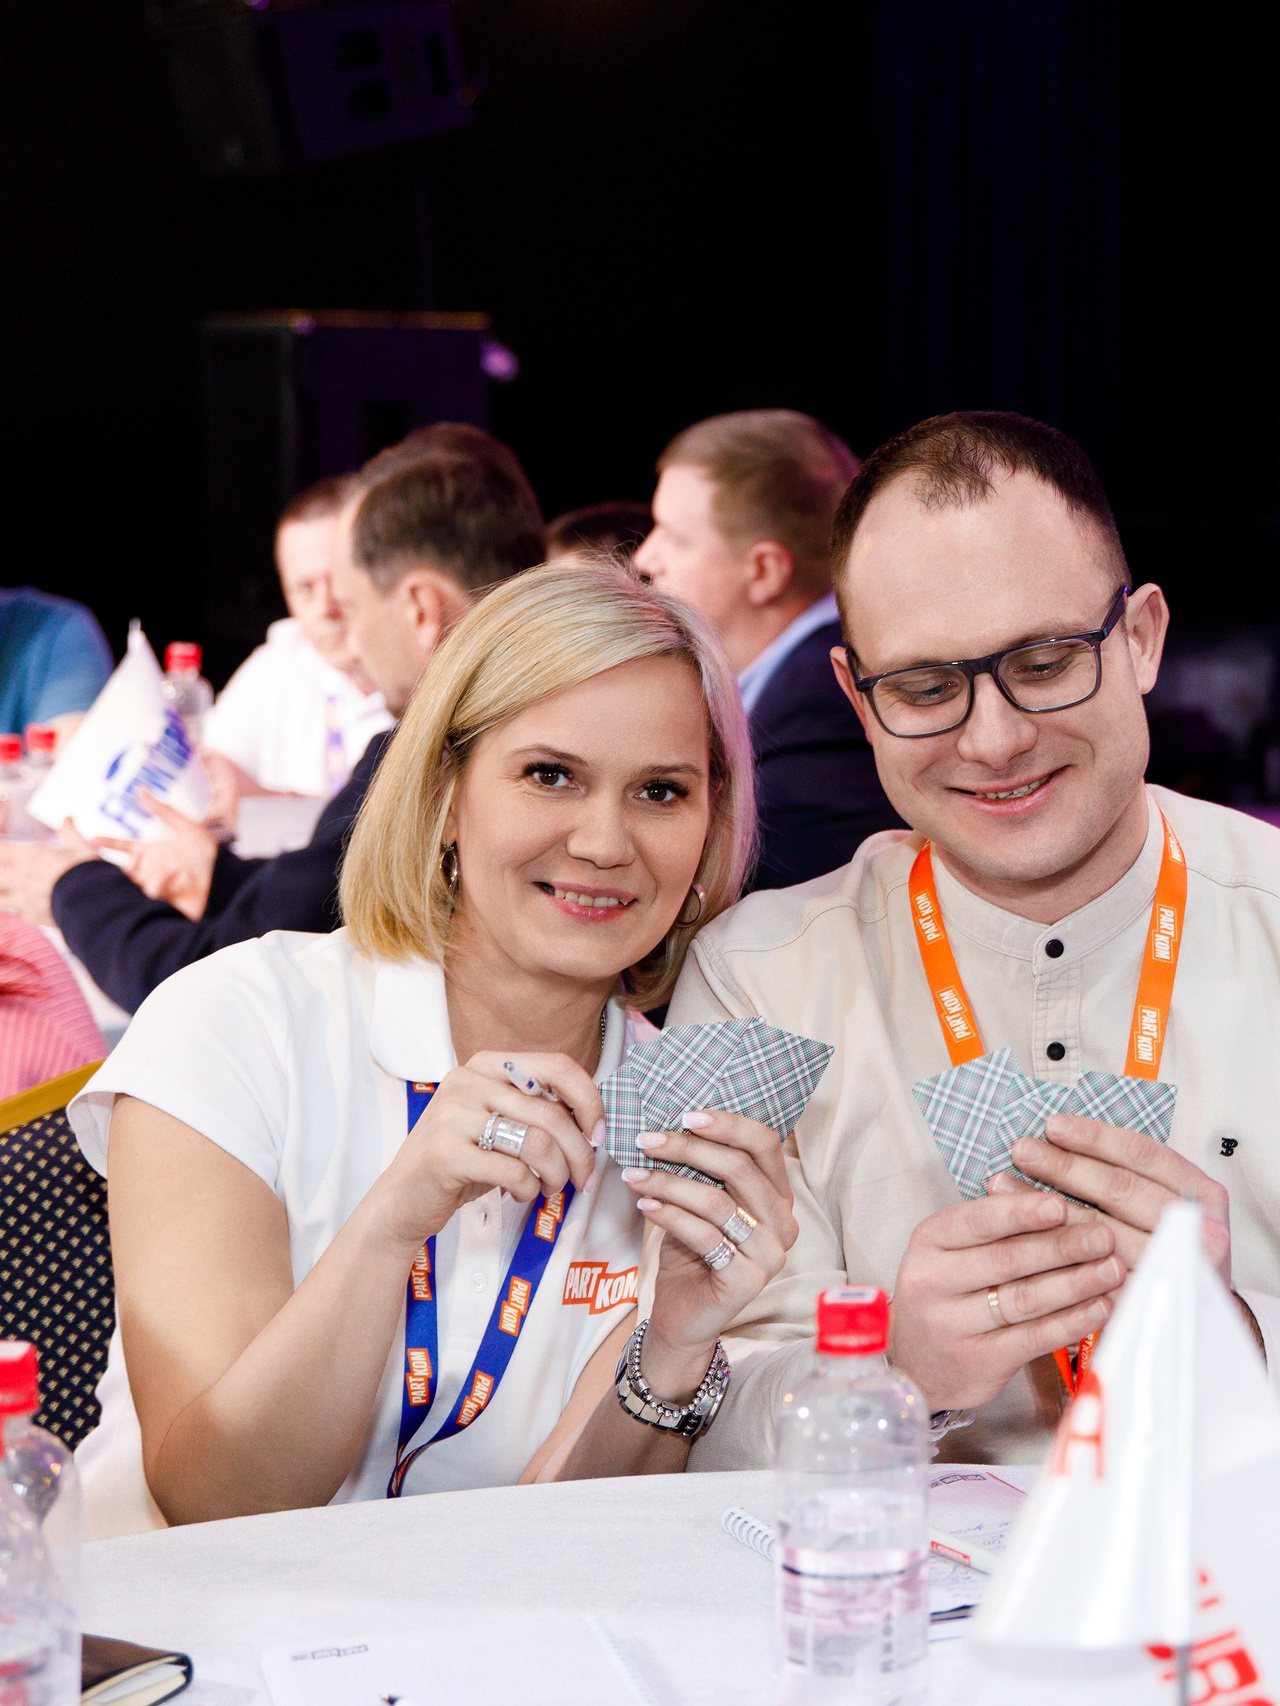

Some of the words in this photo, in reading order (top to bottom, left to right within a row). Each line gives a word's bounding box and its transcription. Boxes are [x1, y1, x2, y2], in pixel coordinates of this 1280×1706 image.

[915, 892, 934, 917] KOM
[919, 916, 941, 941] PART
[1160, 907, 1175, 939] PART
[1155, 933, 1172, 960] KOM
[939, 990, 963, 1014] KOM
[946, 1013, 970, 1040] PART
[1141, 1008, 1158, 1039] PART
[1137, 1034, 1154, 1062] KOM
[536, 1212, 554, 1238] KOM
[411, 1269, 429, 1298] PART
[512, 1279, 529, 1312] PART
[564, 1267, 604, 1300] PART
[594, 1271, 638, 1309] KOM
[501, 1304, 518, 1333] KOM
[411, 1350, 430, 1376] KOM
[408, 1375, 427, 1404] PART
[473, 1373, 491, 1407] PART
[458, 1399, 478, 1425] KOM
